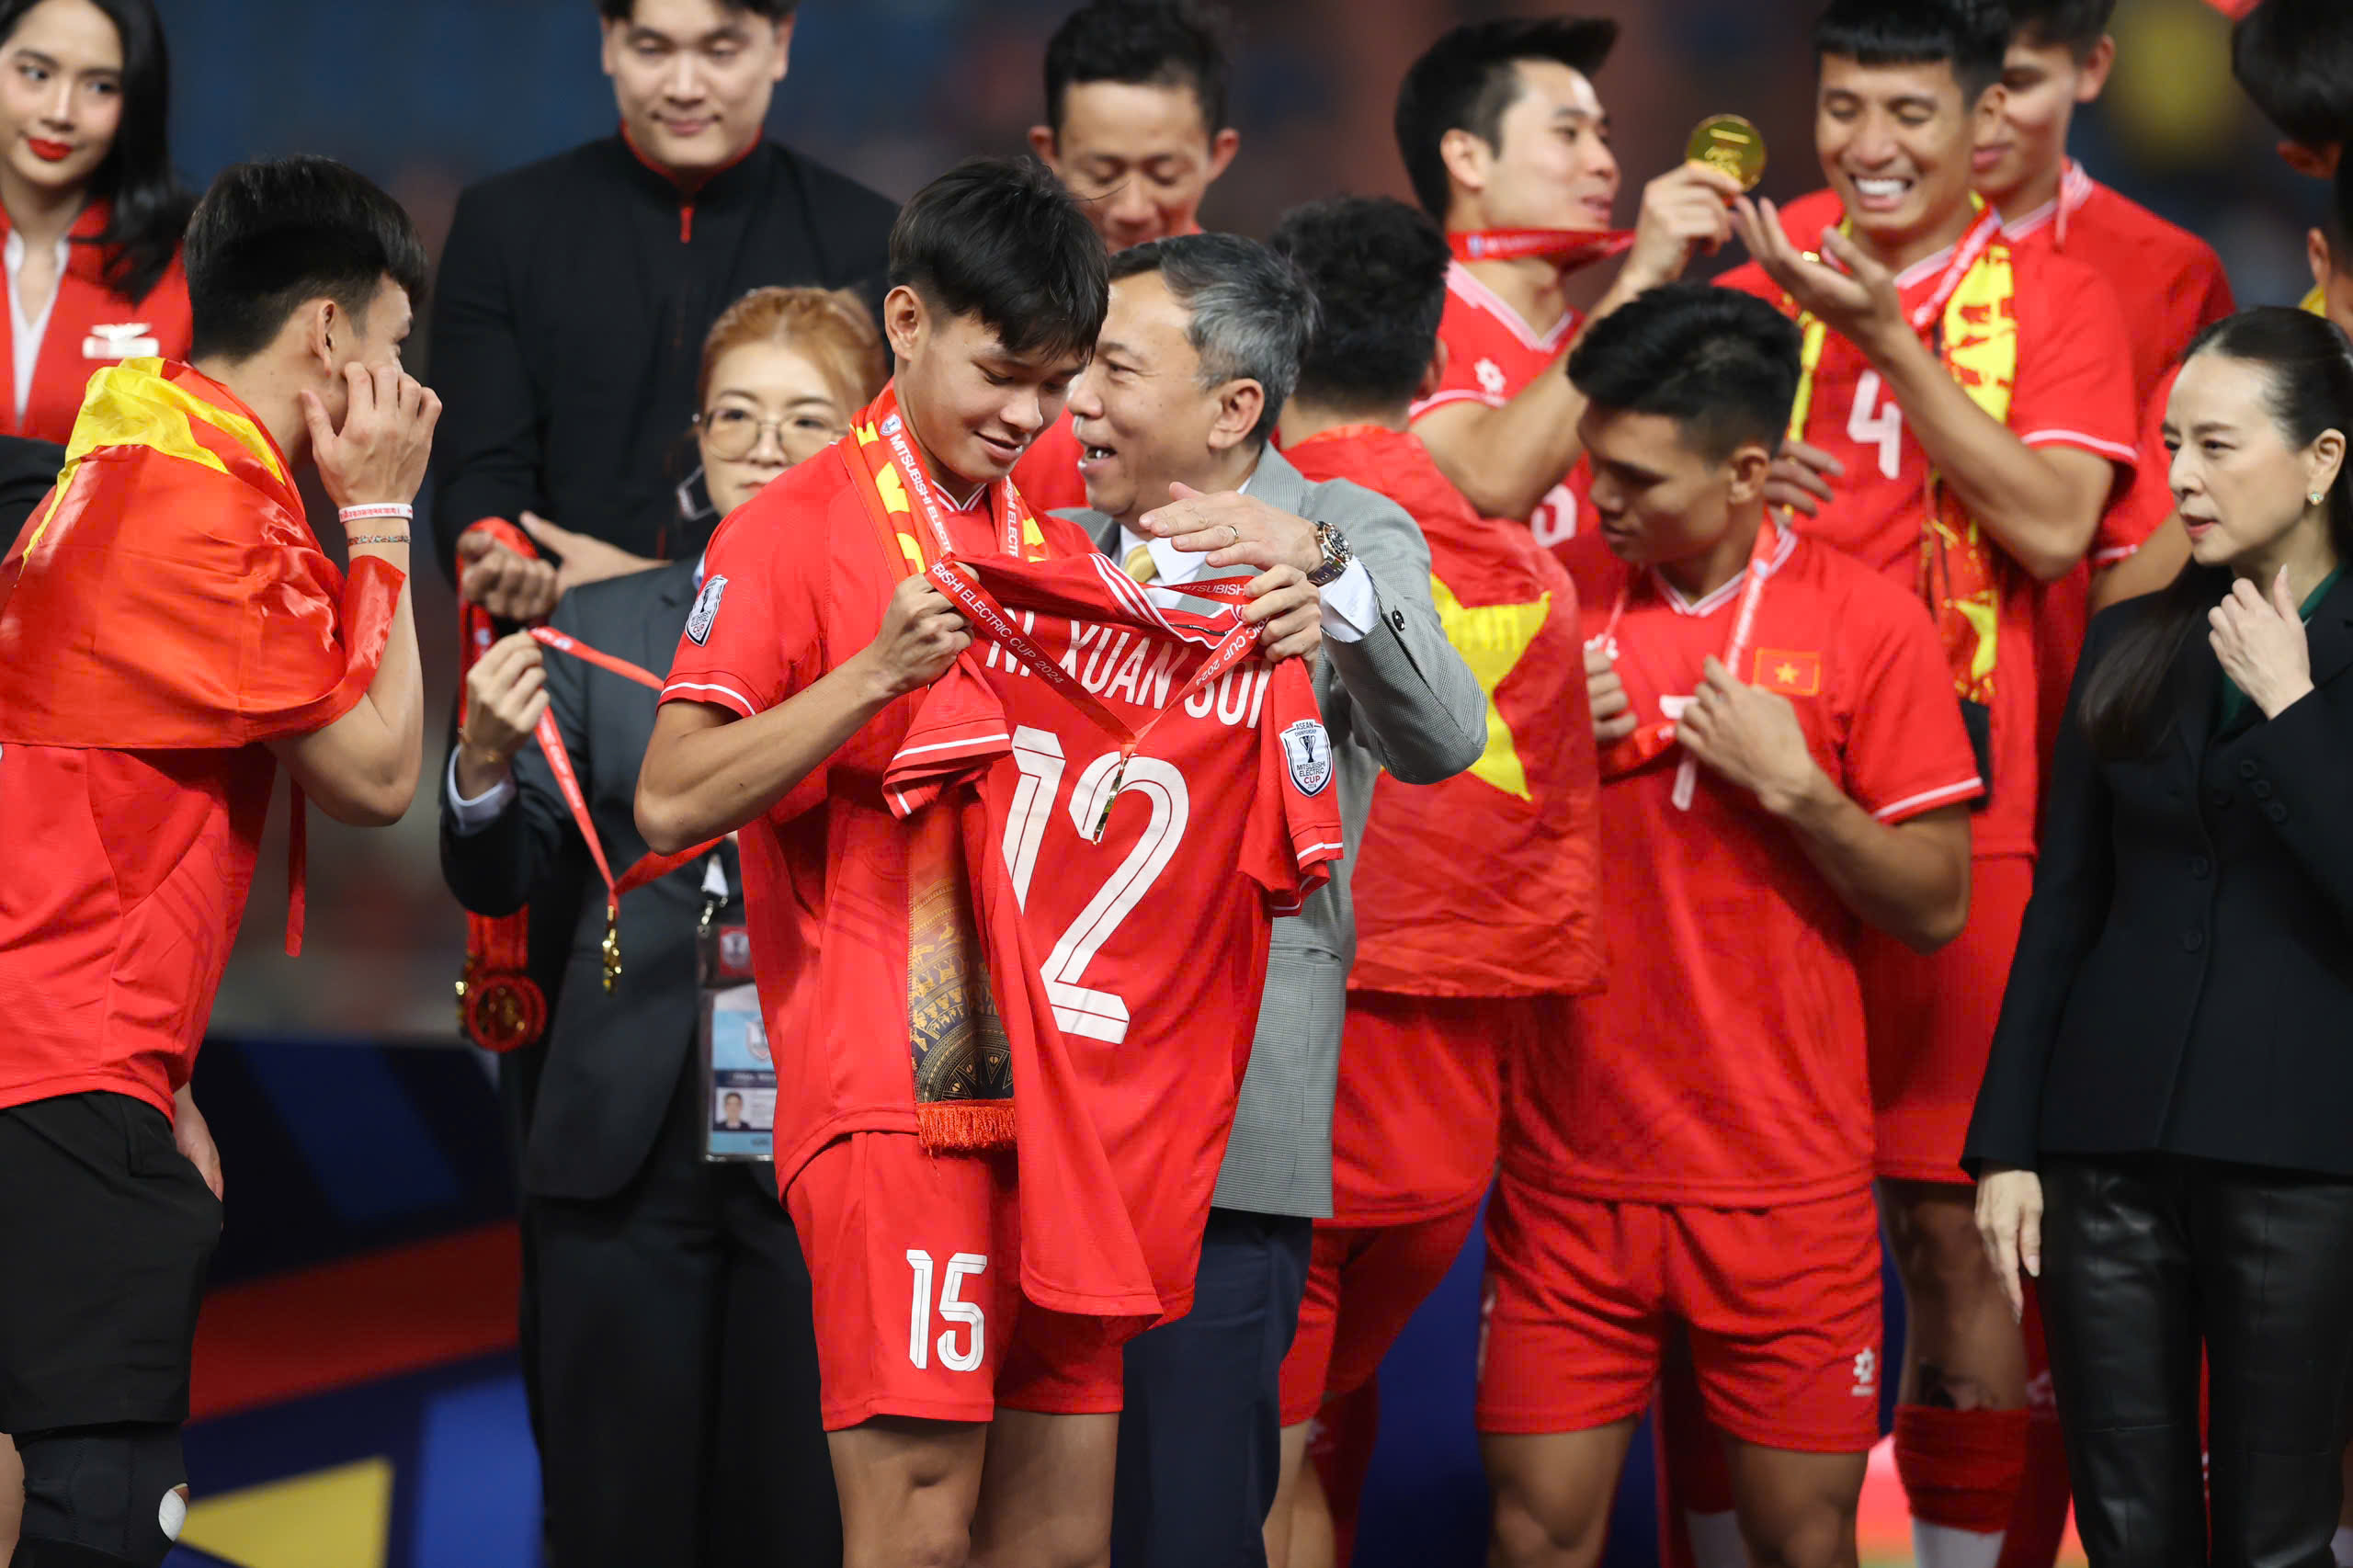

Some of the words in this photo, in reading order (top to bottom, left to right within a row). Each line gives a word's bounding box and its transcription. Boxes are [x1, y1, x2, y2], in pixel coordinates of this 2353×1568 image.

[1847, 369, 1902, 480] 4
[889, 433, 933, 505] MITSUBISHI
[1176, 584, 1246, 597] MITSUBISH
[692, 623, 705, 633] CUP
[959, 588, 1013, 638] ELECTRIC
[1009, 637, 1037, 659] CUP
[1034, 659, 1064, 684] 2024
[1223, 635, 1246, 662] CUP
[1058, 619, 1191, 710] XUAN
[1196, 659, 1222, 686] 2024
[1295, 722, 1314, 731] ASEAN
[1296, 761, 1326, 771] MITSUBISHI
[1299, 767, 1324, 778] ELECTRIC
[1303, 775, 1321, 784] CUP
[1001, 724, 1190, 1045] 12
[906, 1249, 988, 1372] 15
